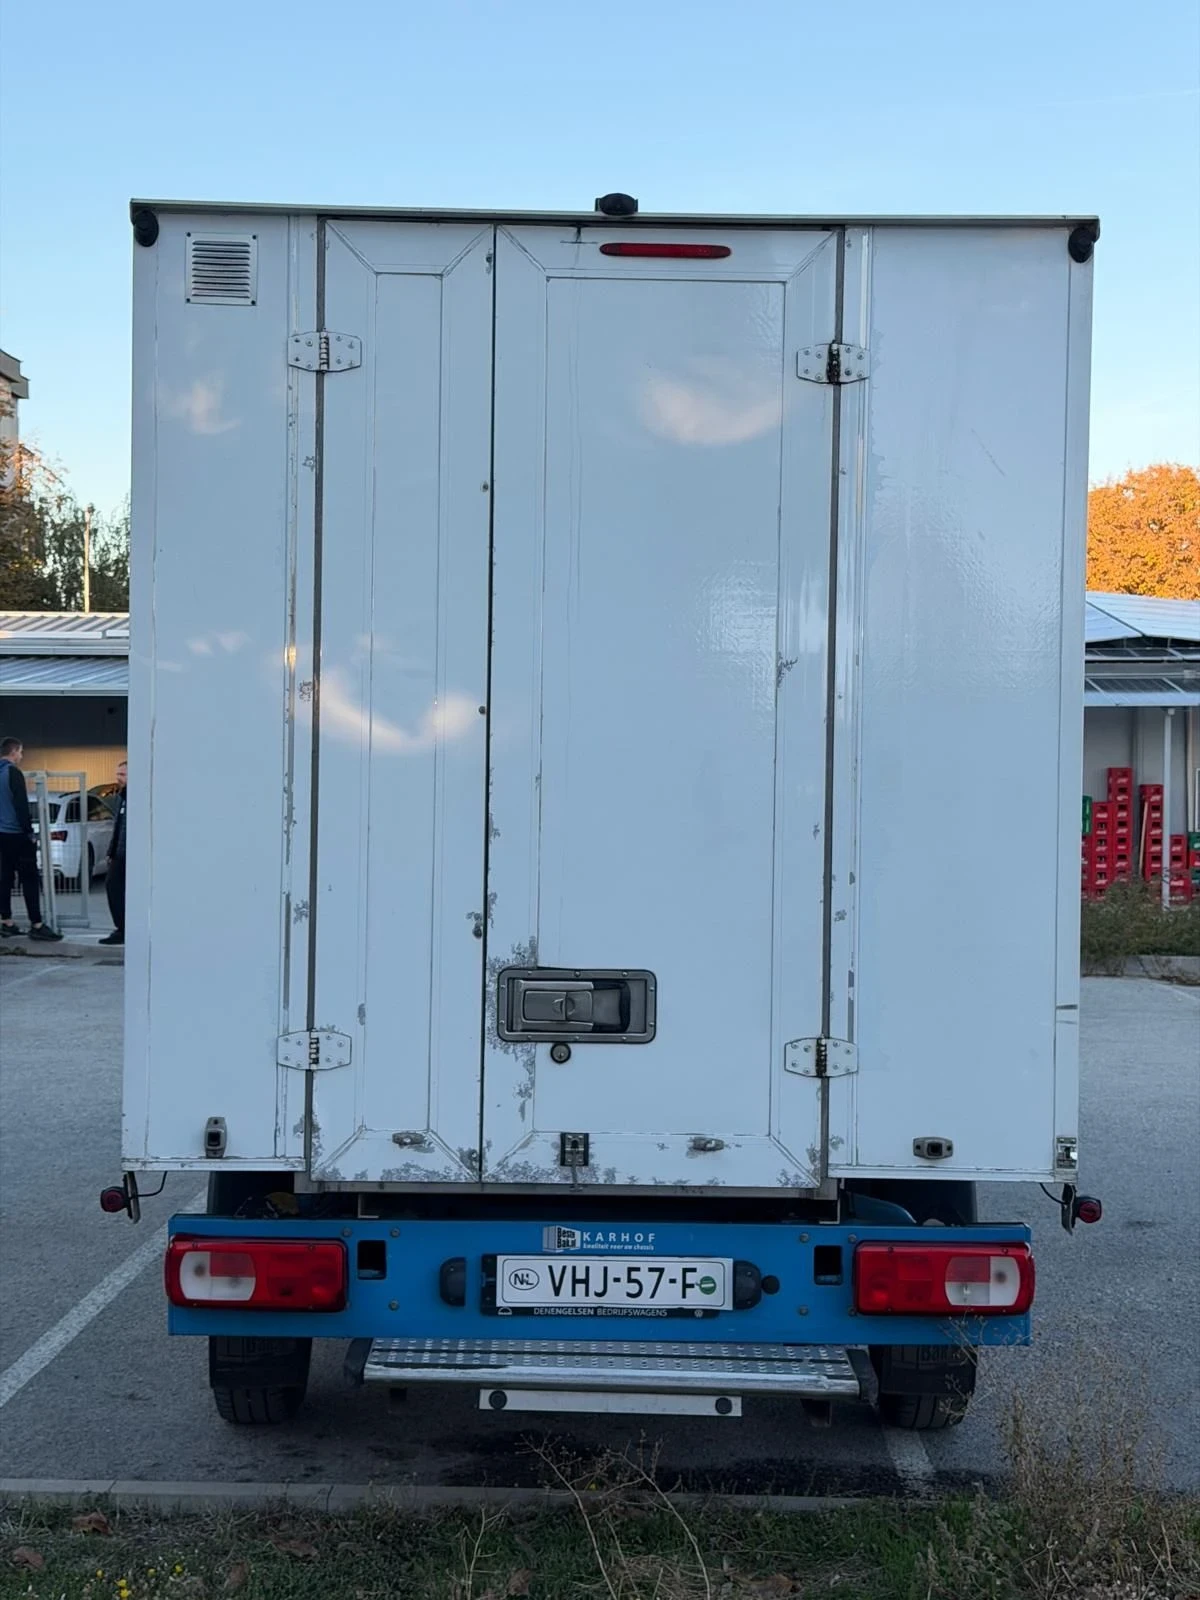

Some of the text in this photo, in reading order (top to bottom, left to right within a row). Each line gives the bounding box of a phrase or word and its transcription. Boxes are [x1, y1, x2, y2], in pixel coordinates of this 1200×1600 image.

[583, 1231, 656, 1243] KARHOF
[513, 1273, 534, 1286] NL
[548, 1264, 698, 1300] VHJ-57-F
[597, 1308, 668, 1317] BEDRIJFSWAGENS
